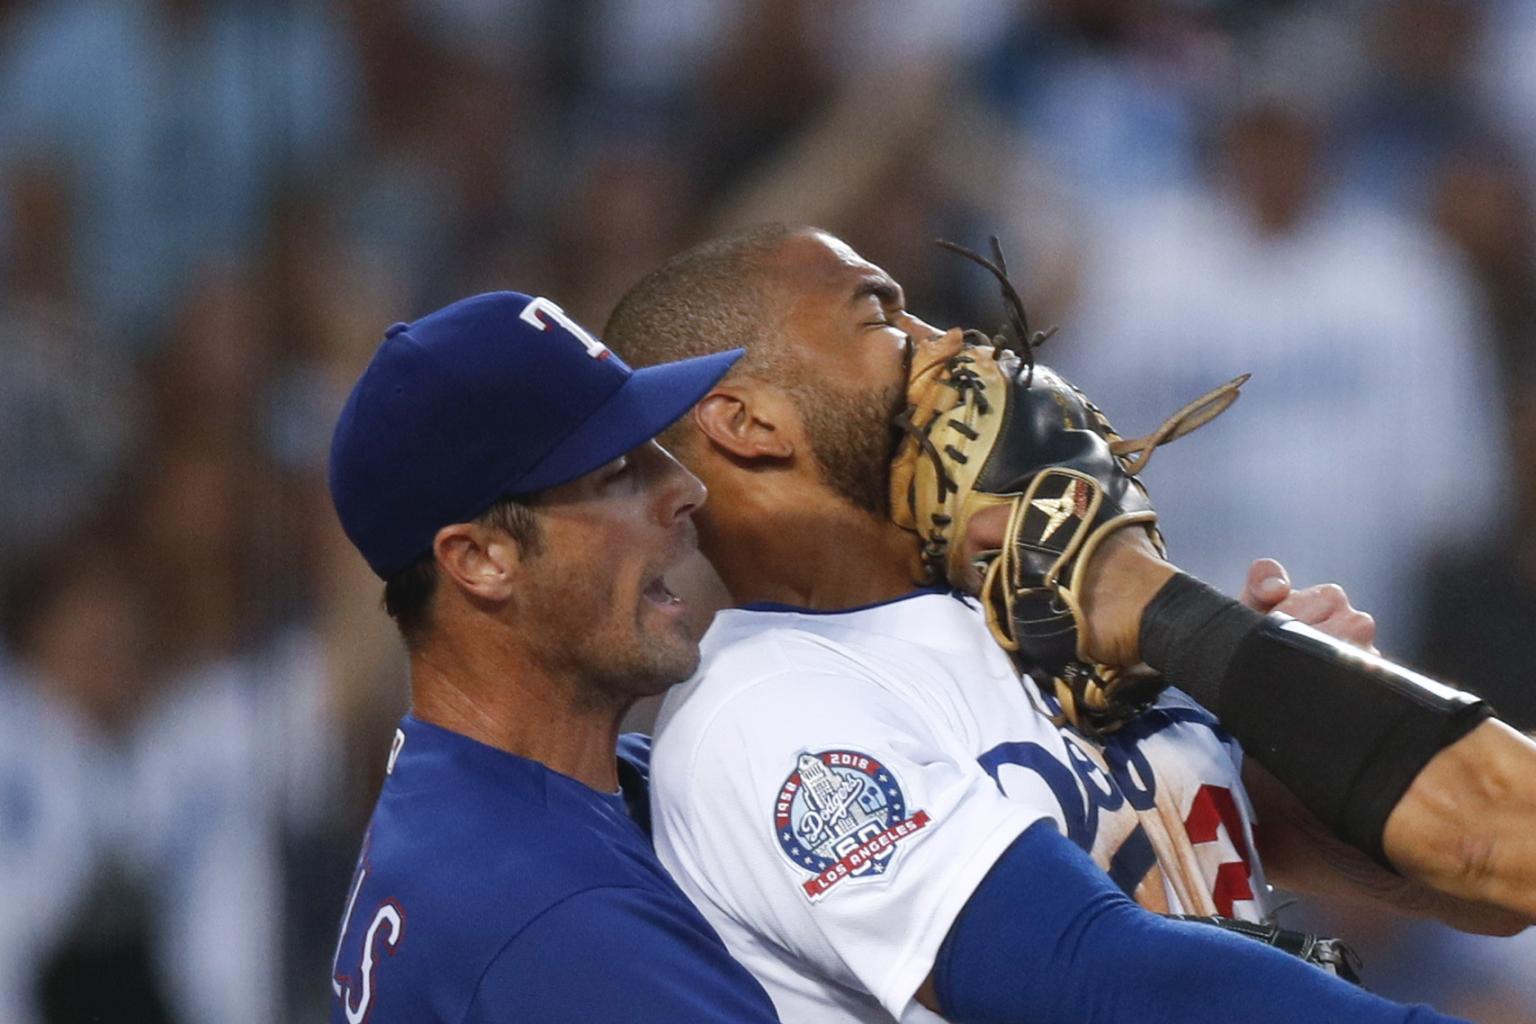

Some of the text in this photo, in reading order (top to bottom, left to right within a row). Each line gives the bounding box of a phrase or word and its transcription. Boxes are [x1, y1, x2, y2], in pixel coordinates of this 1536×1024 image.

[518, 296, 610, 361] T
[829, 753, 870, 770] 2018
[776, 781, 798, 818] 1958
[817, 820, 918, 888] LOS ANGELES
